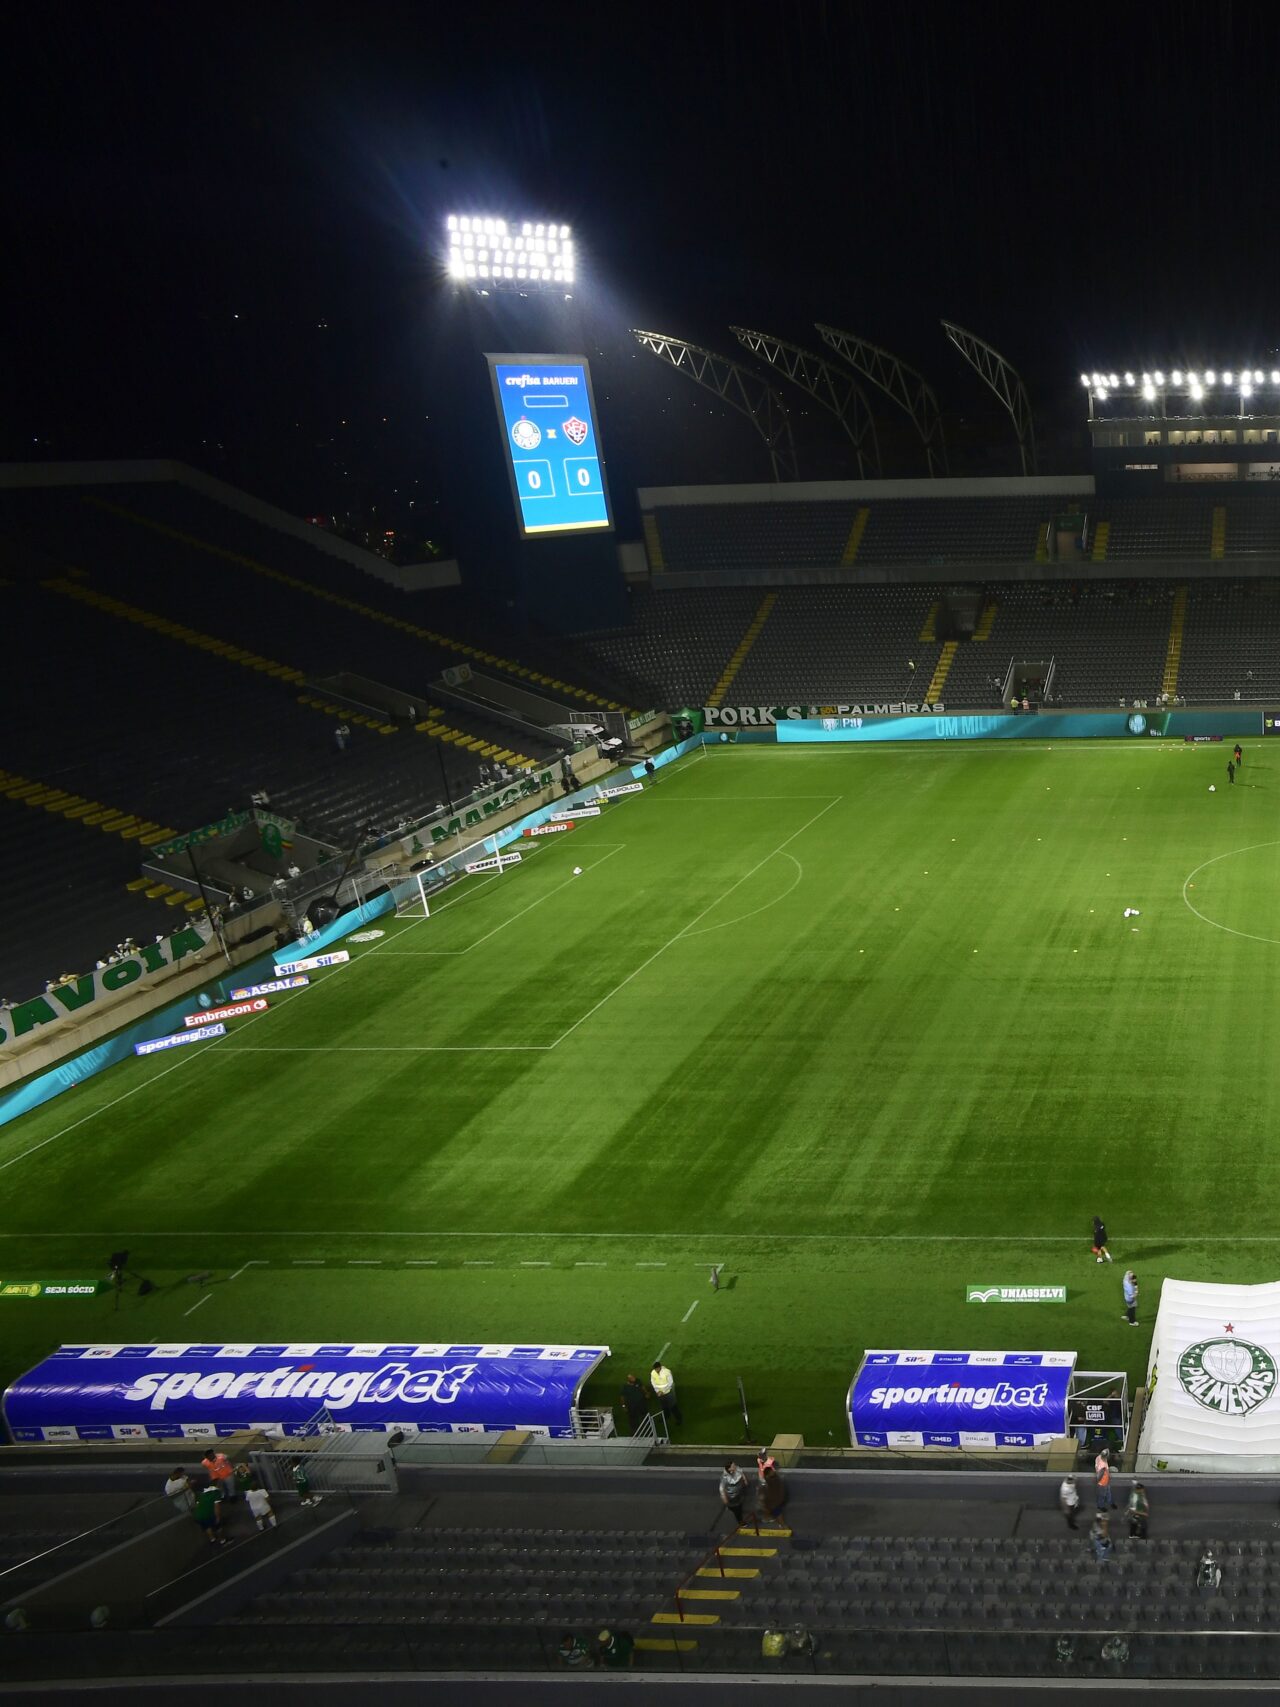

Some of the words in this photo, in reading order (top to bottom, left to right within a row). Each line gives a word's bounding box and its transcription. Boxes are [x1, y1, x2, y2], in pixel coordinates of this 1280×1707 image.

[505, 374, 541, 388] crefisa
[542, 376, 578, 386] BARUERI
[527, 470, 541, 489] 0
[577, 467, 590, 487] 0
[703, 705, 803, 726] PORK'S
[837, 702, 946, 715] PALMEIRAS
[531, 823, 568, 836] Betano
[279, 963, 296, 976] Sil
[316, 955, 332, 967] Sil
[0, 927, 205, 1046] AVOIA
[185, 1002, 251, 1026] Embracon
[137, 1023, 225, 1054] sportingbet
[44, 1286, 67, 1294] SEJA
[67, 1284, 95, 1294] SÓCIO
[1001, 1288, 1064, 1298] UNIASSELVI
[124, 1362, 479, 1411] sportingbet
[869, 1382, 1048, 1410] sportingbet
[1181, 1367, 1274, 1414] PALMEIRAS
[119, 1428, 132, 1436] Sil
[1004, 1436, 1017, 1444] Sil
